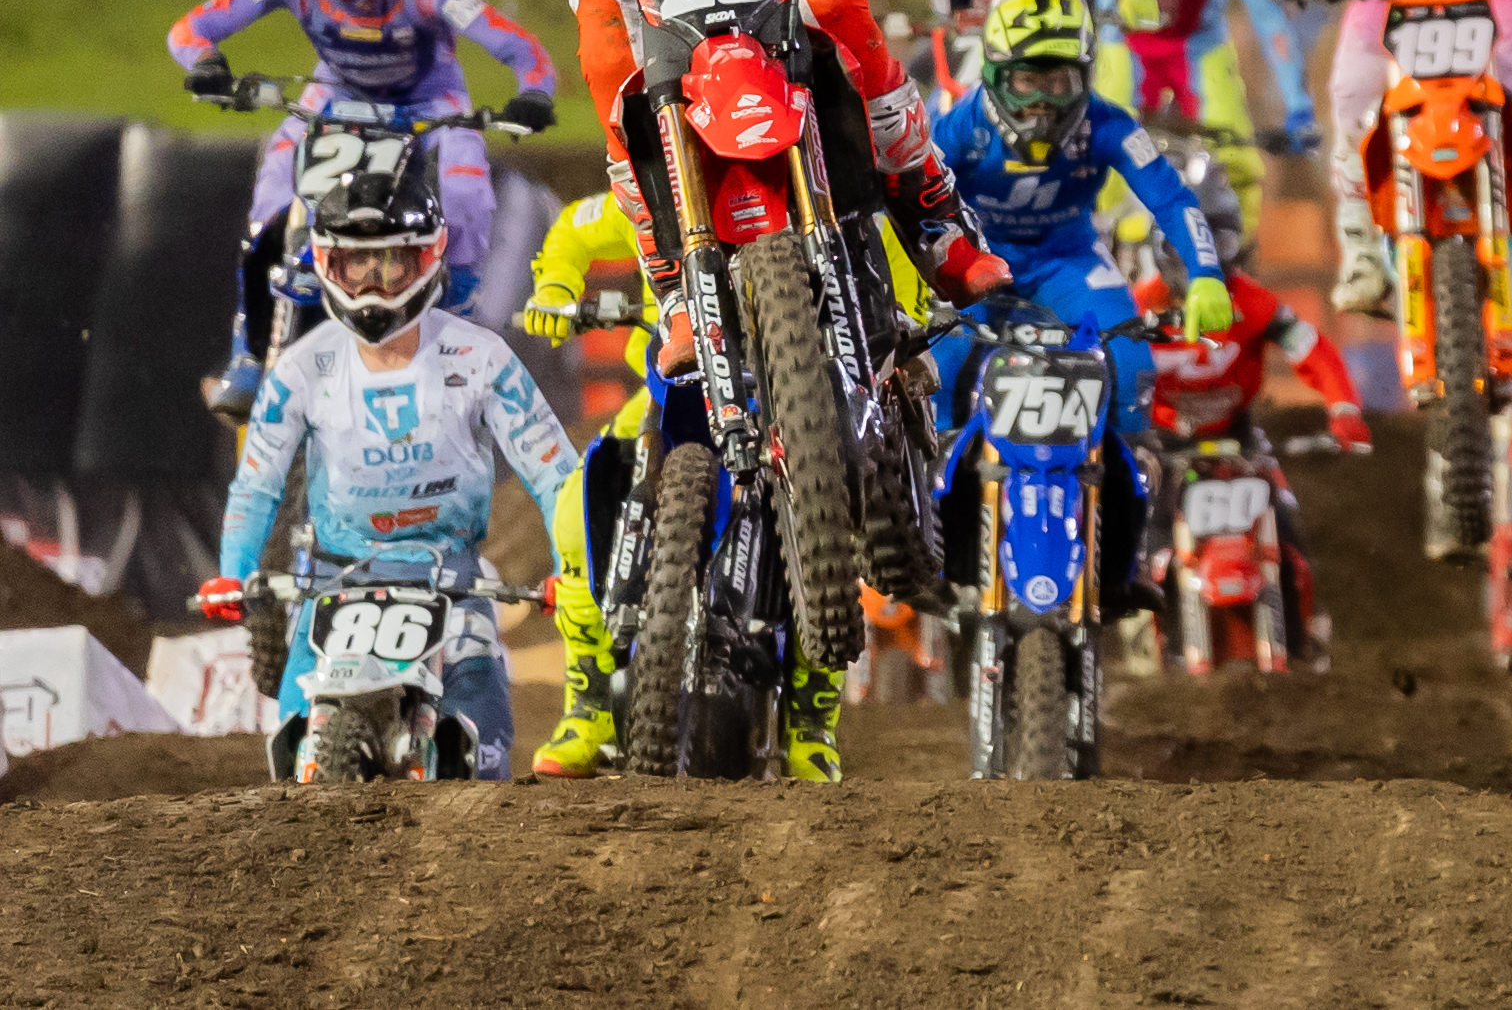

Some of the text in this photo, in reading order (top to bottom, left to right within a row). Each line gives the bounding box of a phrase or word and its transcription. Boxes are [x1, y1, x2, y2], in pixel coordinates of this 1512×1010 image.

[1389, 17, 1495, 78] 199
[298, 132, 405, 197] 21
[990, 375, 1103, 438] 754
[1184, 477, 1271, 537] 60
[323, 601, 433, 661] 86
